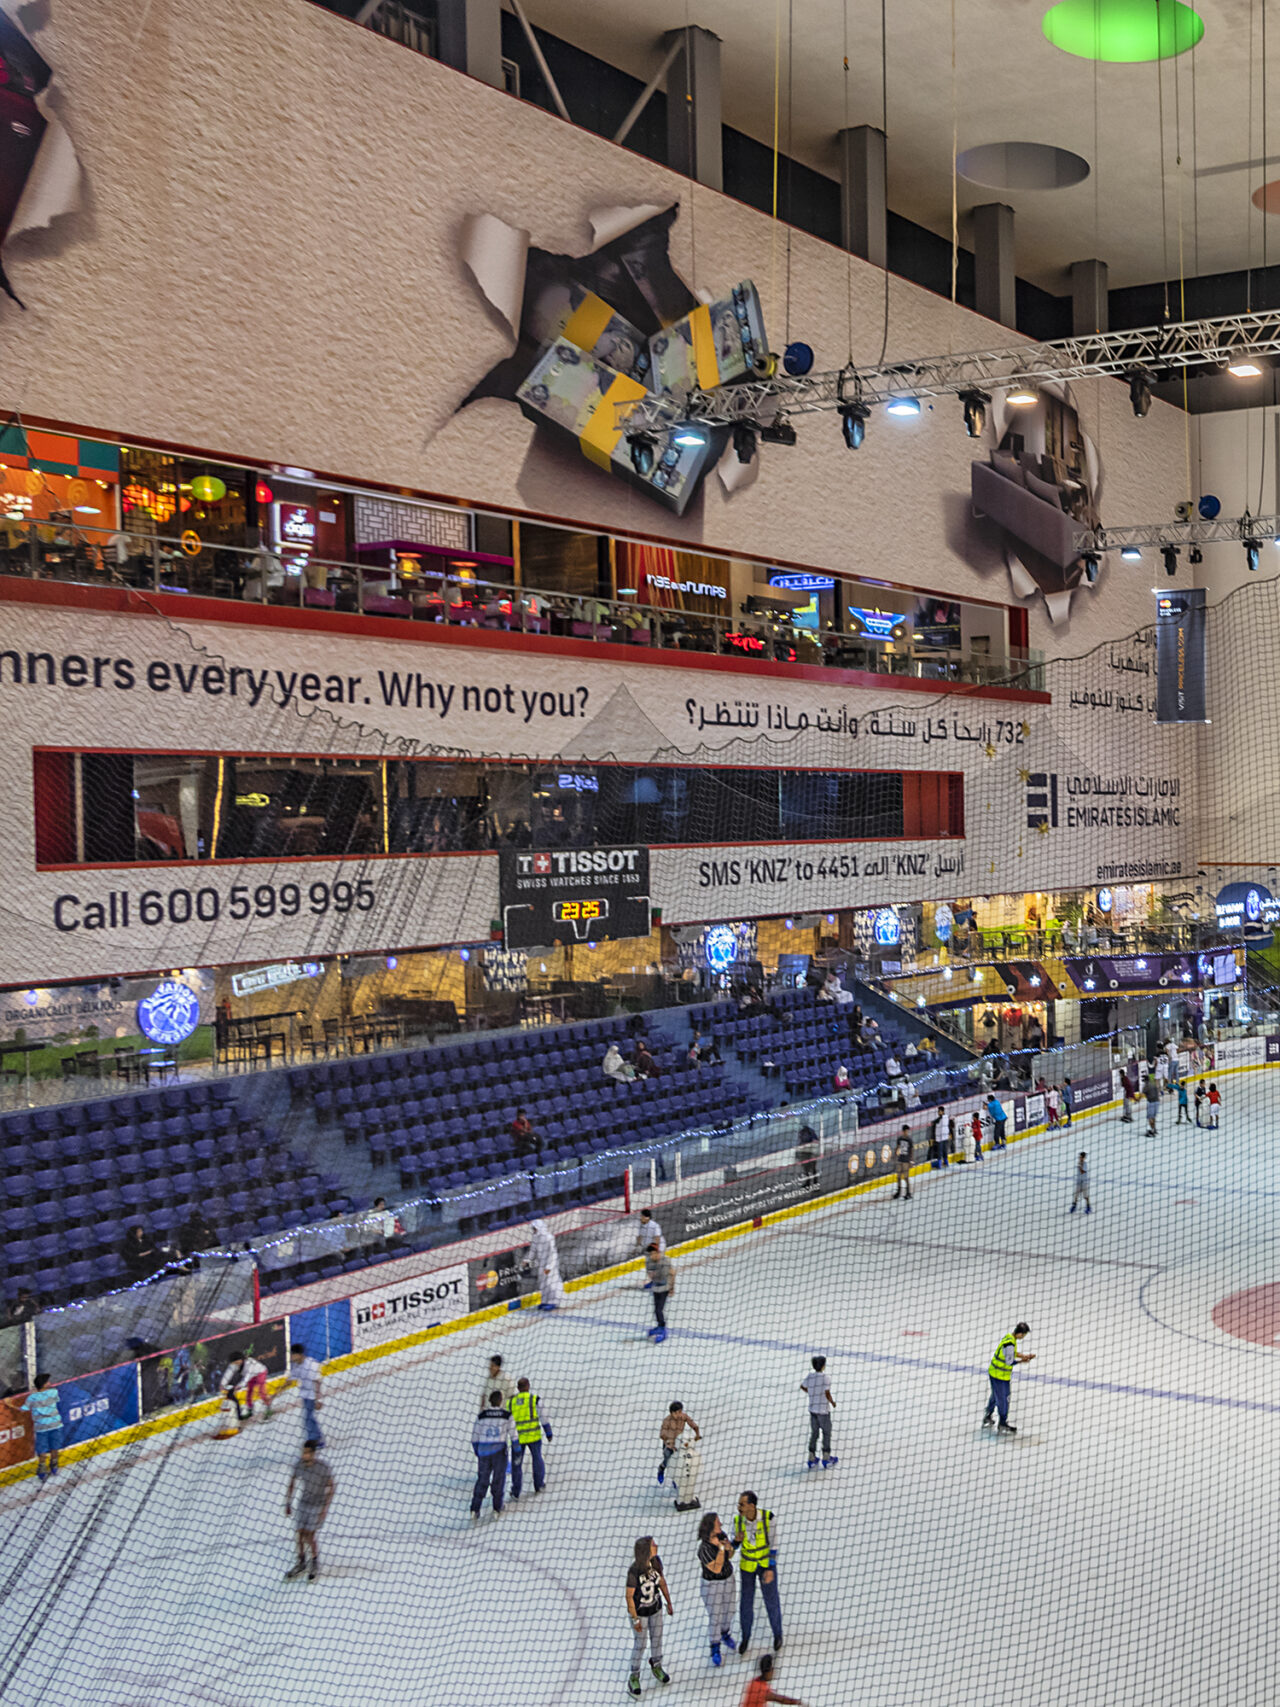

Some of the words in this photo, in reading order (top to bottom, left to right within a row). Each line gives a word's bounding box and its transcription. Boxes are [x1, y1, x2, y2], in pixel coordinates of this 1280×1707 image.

[147, 660, 269, 707] every
[275, 670, 371, 709] year.
[378, 670, 455, 719] Why
[463, 683, 516, 714] not
[521, 686, 590, 723] you?
[921, 715, 948, 743] كل
[996, 720, 1025, 744] 732
[1066, 806, 1132, 828] EMIRATES
[1133, 807, 1181, 827] ISLAMIC
[553, 850, 639, 873] TISSOT
[699, 860, 741, 888] SMS
[795, 861, 813, 881] to
[816, 855, 859, 879] 4451
[551, 874, 591, 887] WATCHES
[53, 890, 129, 932] Call
[138, 887, 220, 926] 600
[229, 883, 300, 919] 599
[308, 880, 375, 915] 995
[387, 1278, 463, 1314] TISSOT
[640, 1580, 655, 1604] 9
